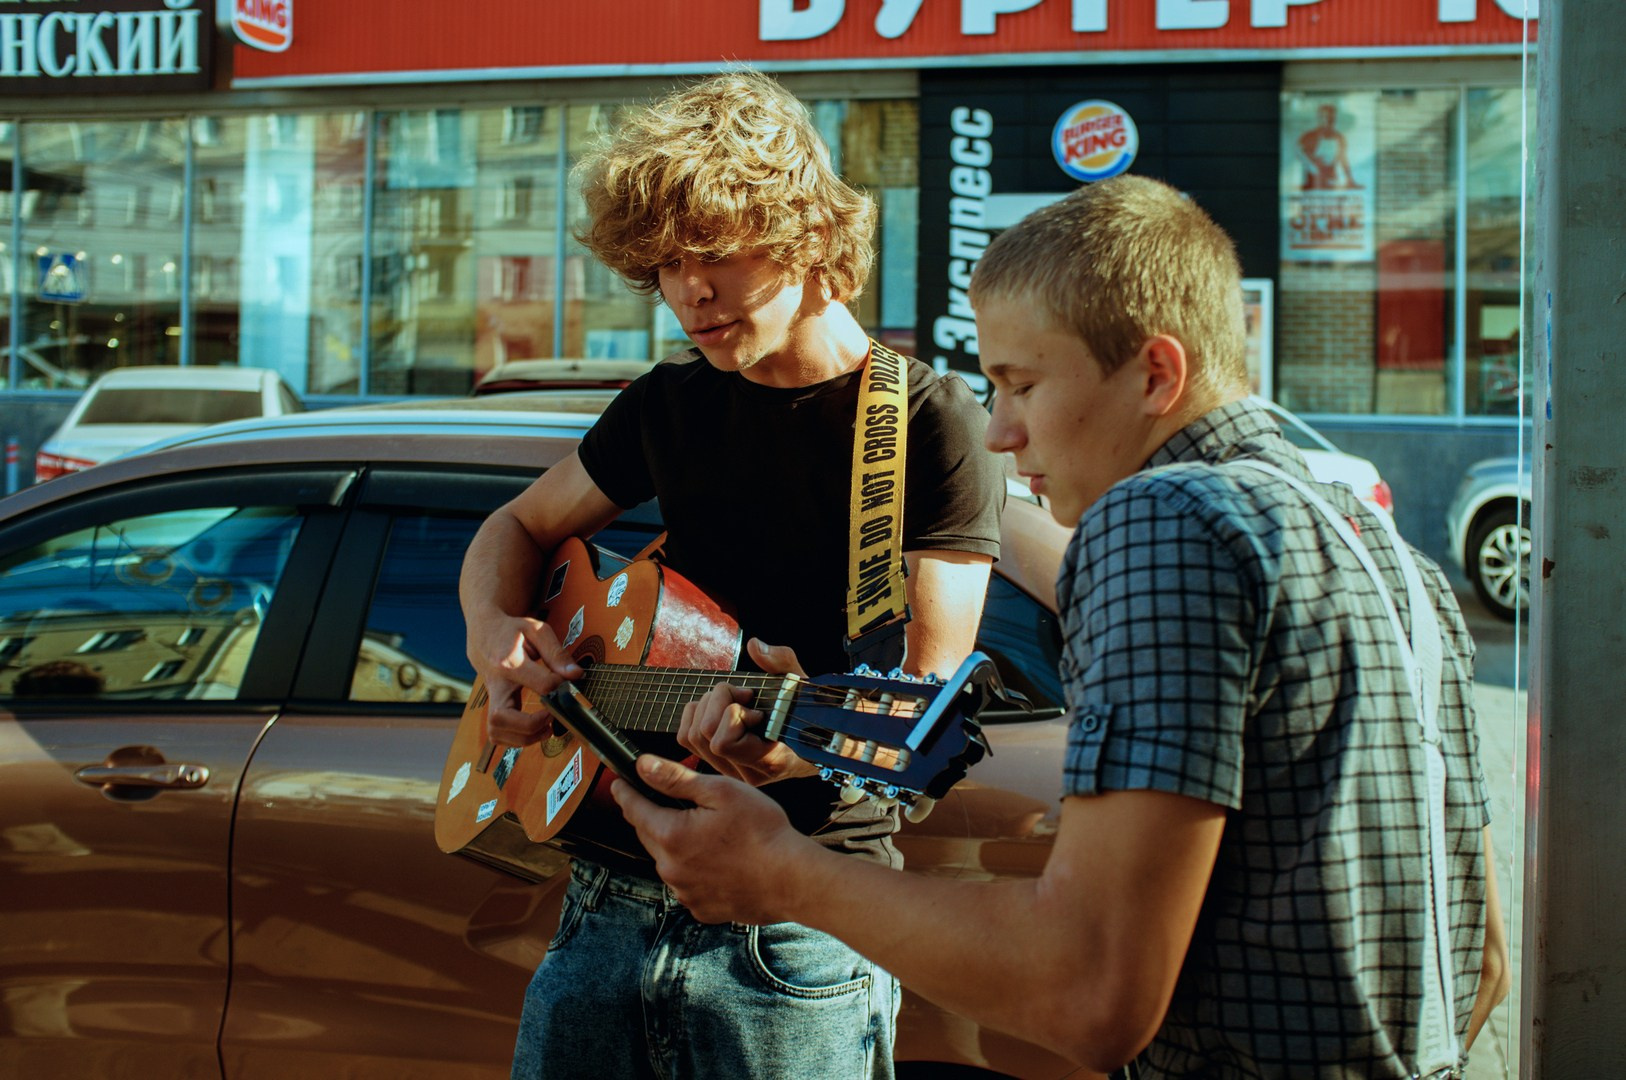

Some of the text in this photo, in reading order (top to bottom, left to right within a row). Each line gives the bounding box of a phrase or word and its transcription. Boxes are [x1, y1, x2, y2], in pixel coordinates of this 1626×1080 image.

[1063, 127, 1126, 164] KING
[863, 403, 899, 465] CROSS
[861, 469, 895, 513] NOT
[859, 514, 893, 551] DO
